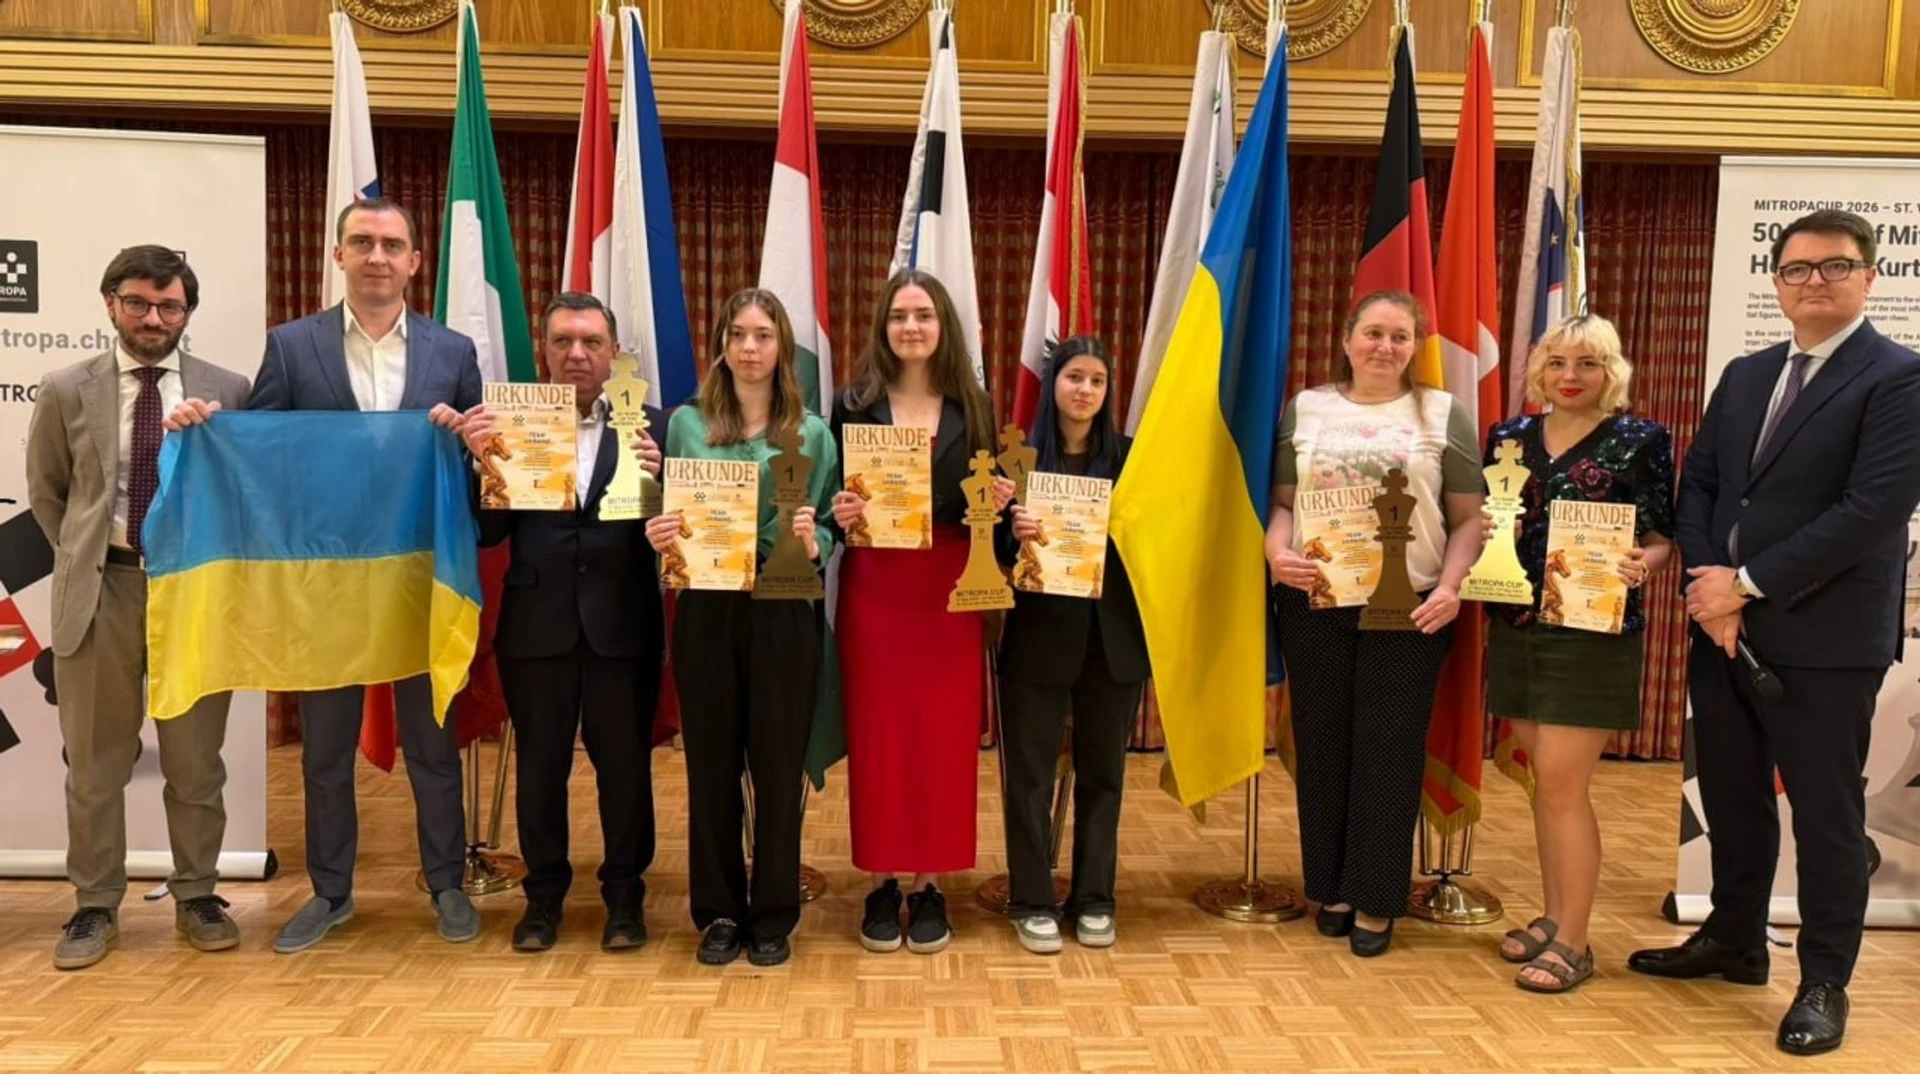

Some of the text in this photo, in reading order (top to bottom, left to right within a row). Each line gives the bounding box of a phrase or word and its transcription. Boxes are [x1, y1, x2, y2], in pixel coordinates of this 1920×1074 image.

[1754, 199, 1843, 211] MITROPACUP
[1847, 201, 1879, 213] 2026
[1894, 202, 1913, 214] ST.
[1889, 225, 1920, 245] Mi
[484, 384, 573, 405] URKUNDE
[620, 389, 630, 406] 1
[844, 425, 928, 447] URKUNDE
[666, 460, 756, 482] URKUNDE
[784, 465, 794, 483] 1
[1014, 460, 1023, 475] 1
[1029, 472, 1109, 499] URKUNDE
[1499, 475, 1509, 492] 1
[976, 488, 985, 503] 1
[1391, 505, 1399, 522] 1
[1552, 502, 1633, 526] URKUNDE
